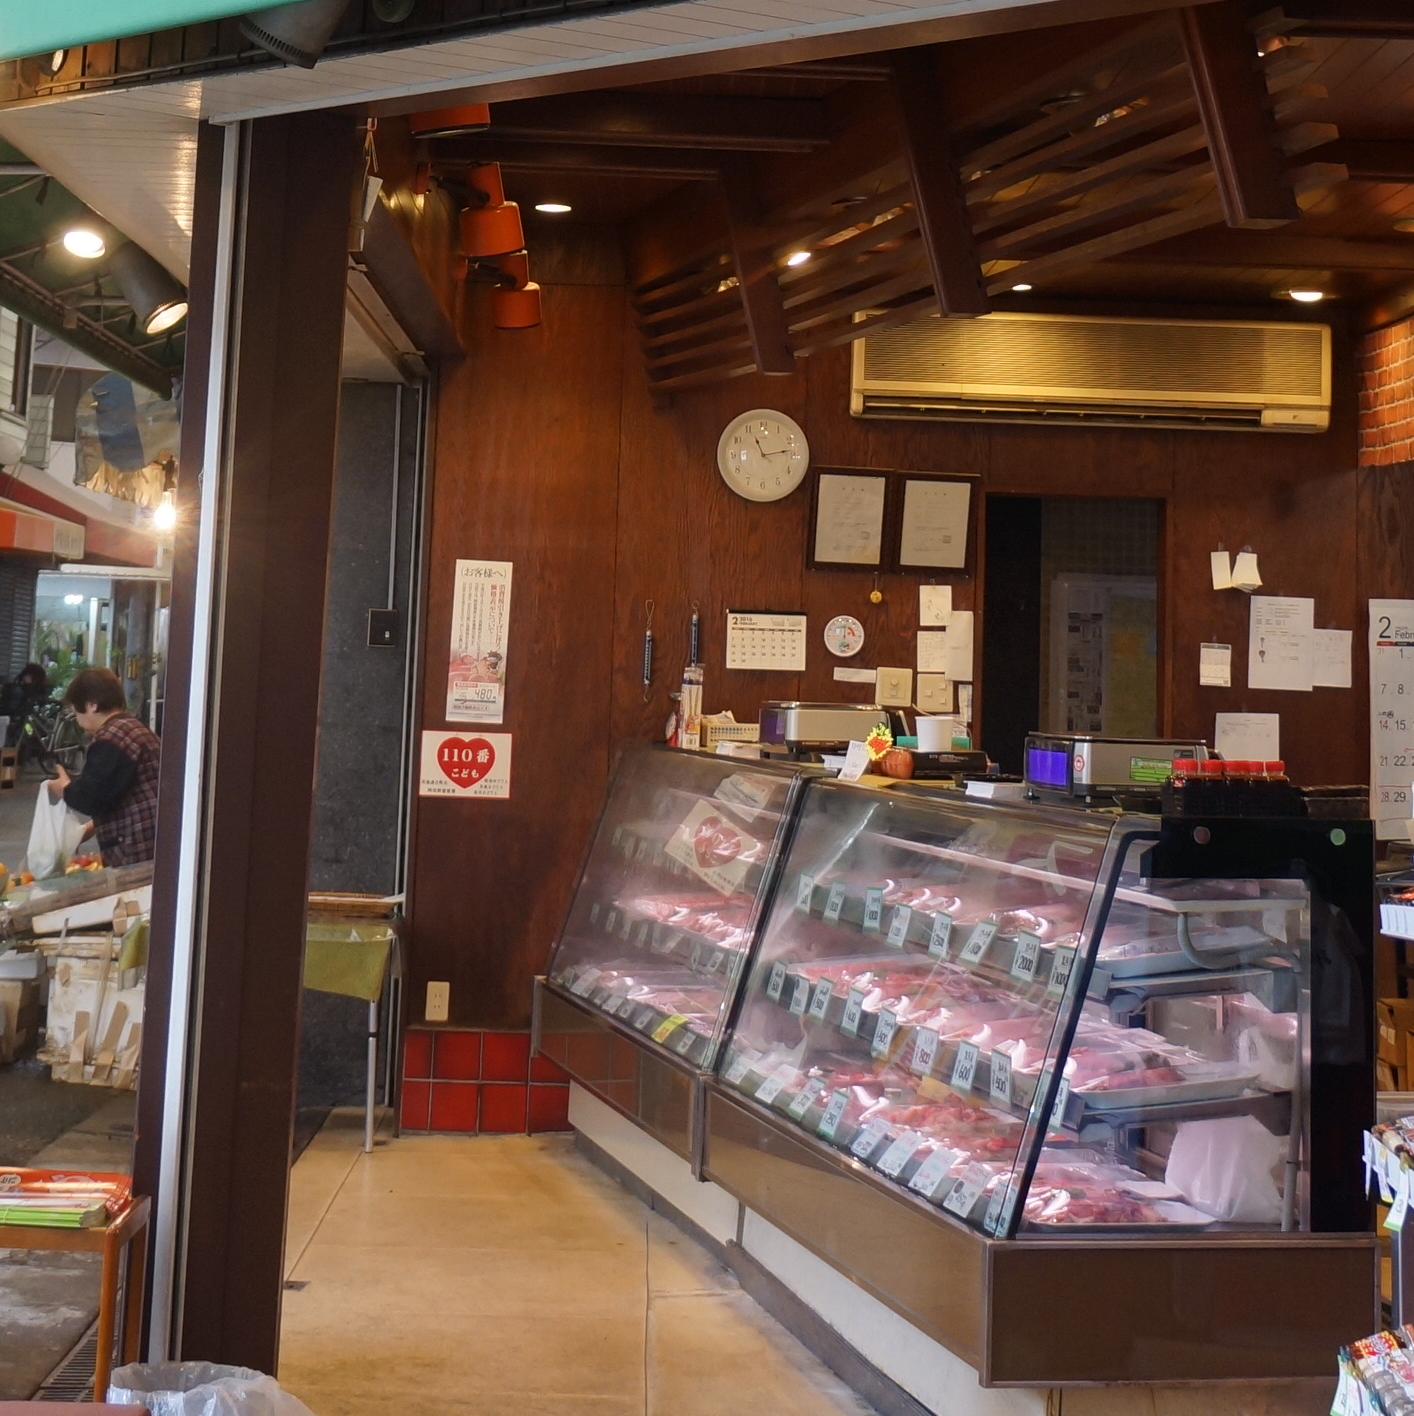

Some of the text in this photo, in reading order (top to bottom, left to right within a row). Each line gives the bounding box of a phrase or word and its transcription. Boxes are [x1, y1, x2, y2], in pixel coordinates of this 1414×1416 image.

[731, 616, 739, 626] 2
[1378, 616, 1392, 639] 2
[1398, 649, 1405, 660] 1
[474, 688, 493, 700] 480
[1380, 683, 1387, 695] 7
[1397, 683, 1405, 695] 8
[1379, 719, 1389, 731] 14
[1395, 720, 1407, 731] 15
[442, 747, 490, 764] 110番
[1393, 755, 1406, 767] 22
[451, 768, 480, 779] こども
[1380, 790, 1407, 803] 28 29
